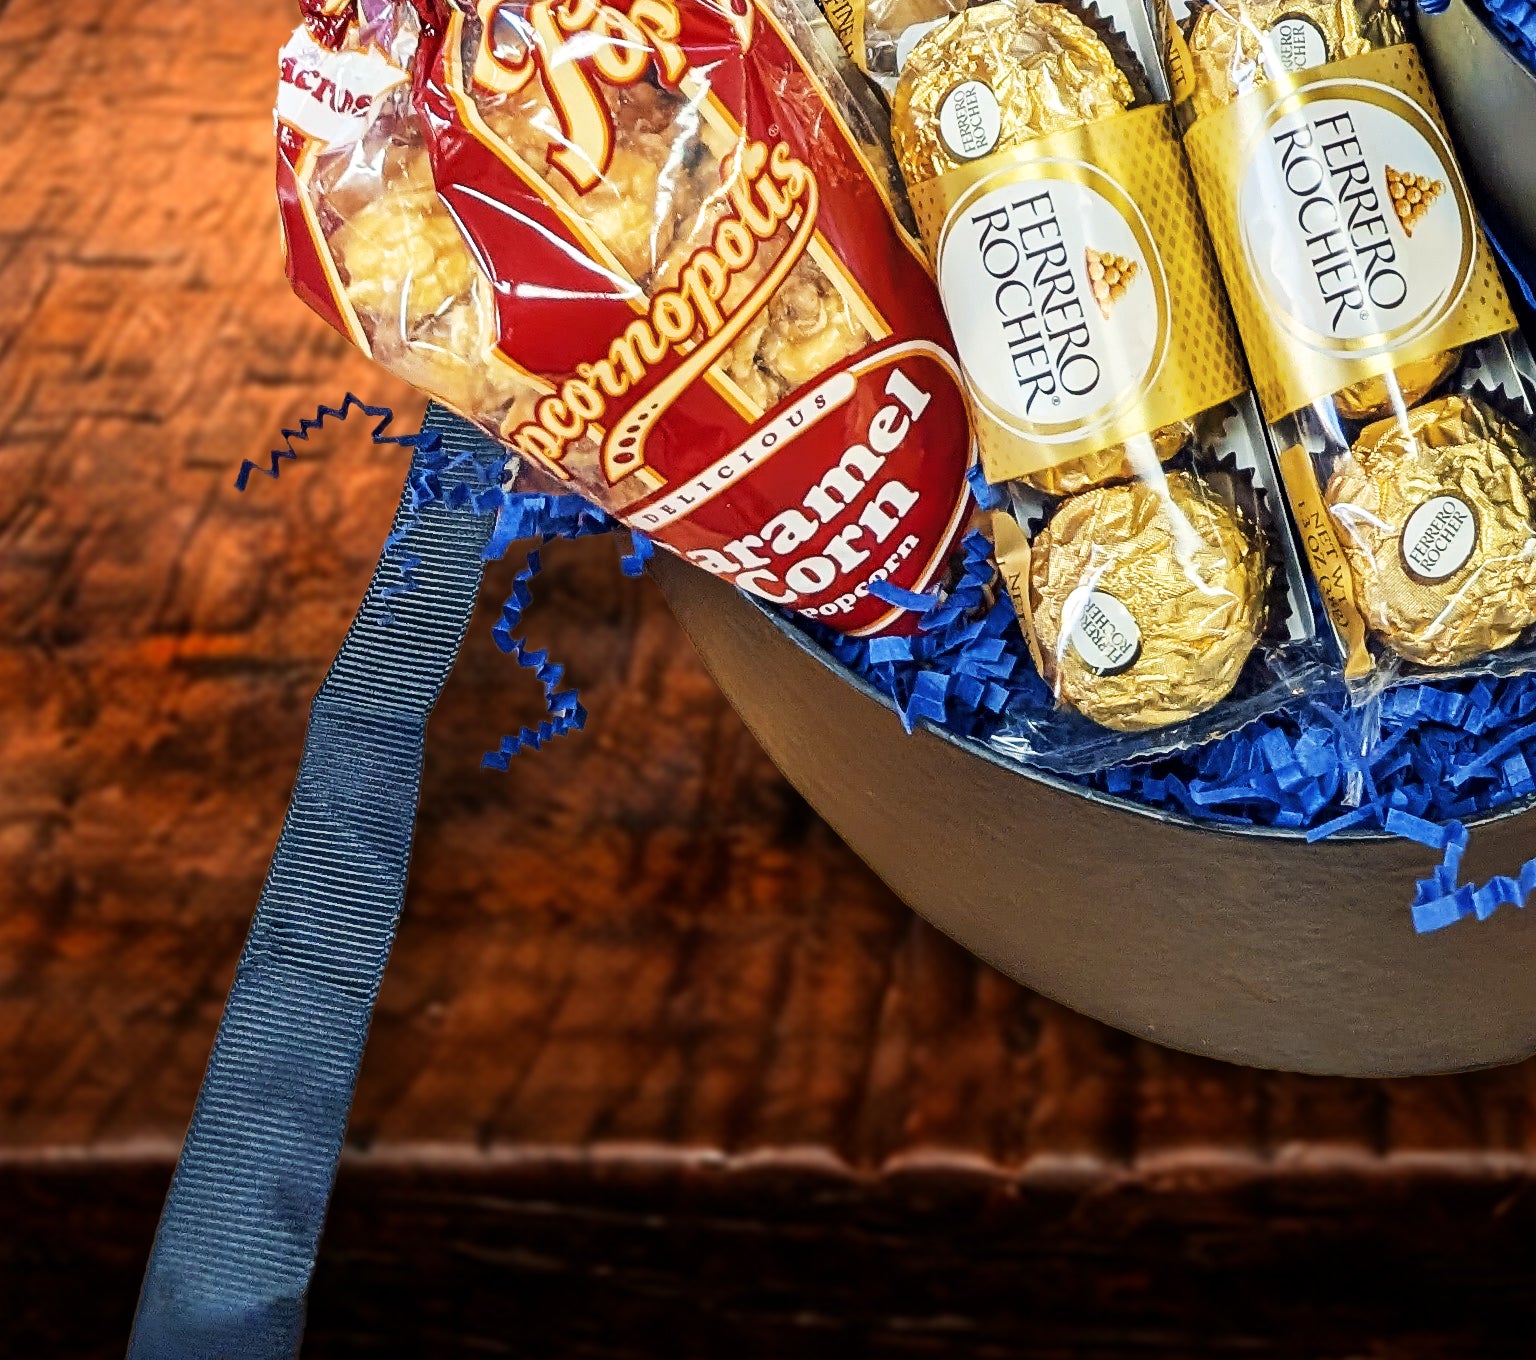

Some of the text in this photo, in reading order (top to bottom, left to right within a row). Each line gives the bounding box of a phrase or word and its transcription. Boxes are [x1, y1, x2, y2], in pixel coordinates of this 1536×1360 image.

[952, 89, 976, 153] FERRERO
[967, 85, 989, 150] ROCHER
[1274, 123, 1365, 332] ROCHER
[1314, 110, 1408, 310] FERRERO
[970, 205, 1058, 416] ROCHER
[1011, 190, 1101, 397] FERRERO
[642, 394, 827, 525] DELICIOUS
[736, 480, 920, 605] Corn
[1307, 534, 1328, 570] OZ
[1310, 512, 1339, 559] NET
[1409, 500, 1456, 564] FERRERO
[1420, 509, 1469, 573] ROCHER
[1084, 599, 1133, 654] ROCHER
